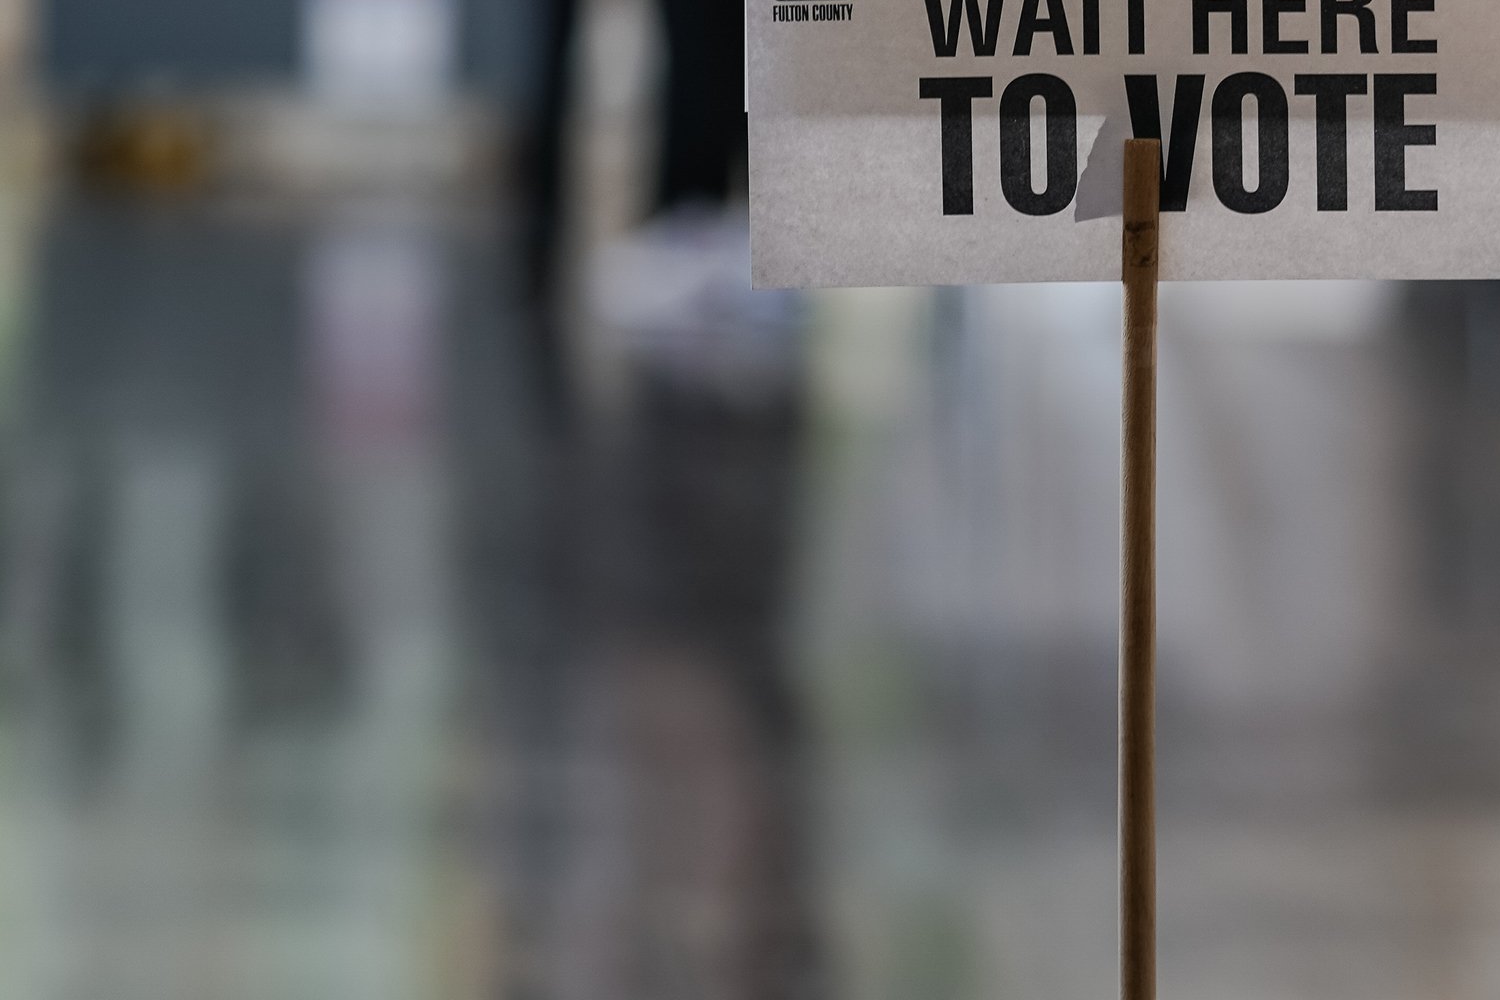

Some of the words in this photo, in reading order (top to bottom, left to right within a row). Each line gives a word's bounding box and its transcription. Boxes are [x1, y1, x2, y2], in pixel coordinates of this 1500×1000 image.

[773, 5, 809, 22] FULTON
[812, 4, 853, 21] COUNTY
[918, 73, 1078, 217] TO
[1124, 71, 1438, 215] VOTE
